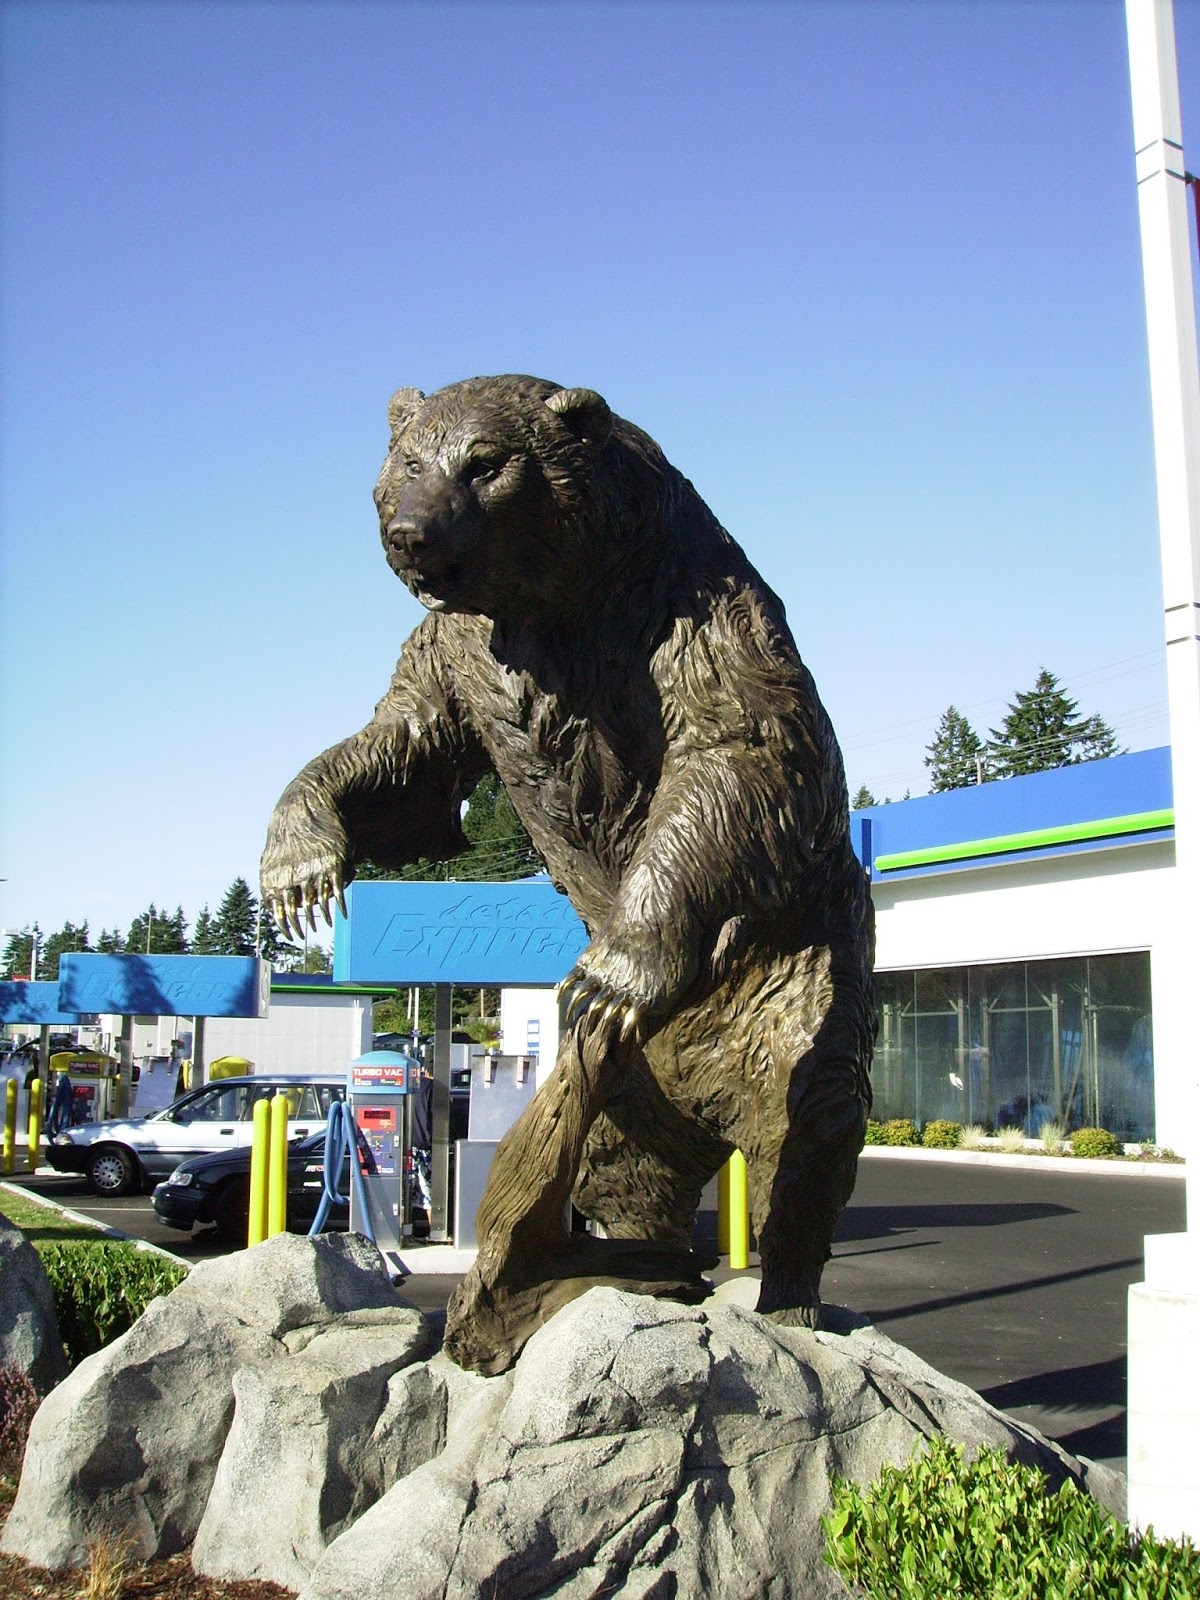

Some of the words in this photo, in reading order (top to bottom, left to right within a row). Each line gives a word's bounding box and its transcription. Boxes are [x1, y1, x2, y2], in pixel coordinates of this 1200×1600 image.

[373, 913, 587, 969] Expres
[353, 1068, 382, 1076] TURBO
[384, 1068, 403, 1076] VAC
